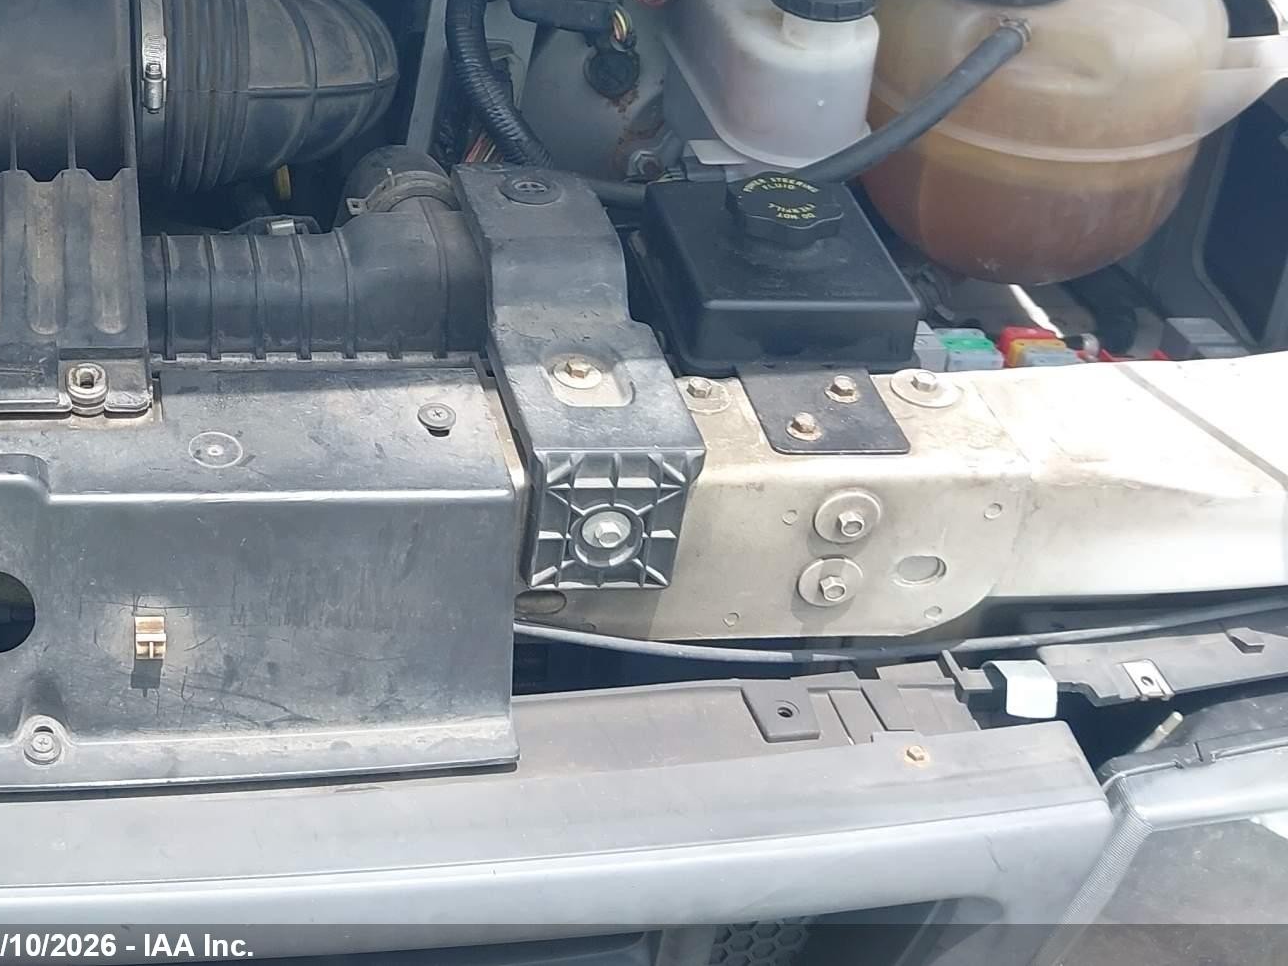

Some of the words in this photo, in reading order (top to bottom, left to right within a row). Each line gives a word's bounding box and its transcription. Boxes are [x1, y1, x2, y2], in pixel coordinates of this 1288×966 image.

[761, 183, 796, 191] FLUID
[770, 177, 820, 193] STEERING
[776, 212, 799, 220] NOT
